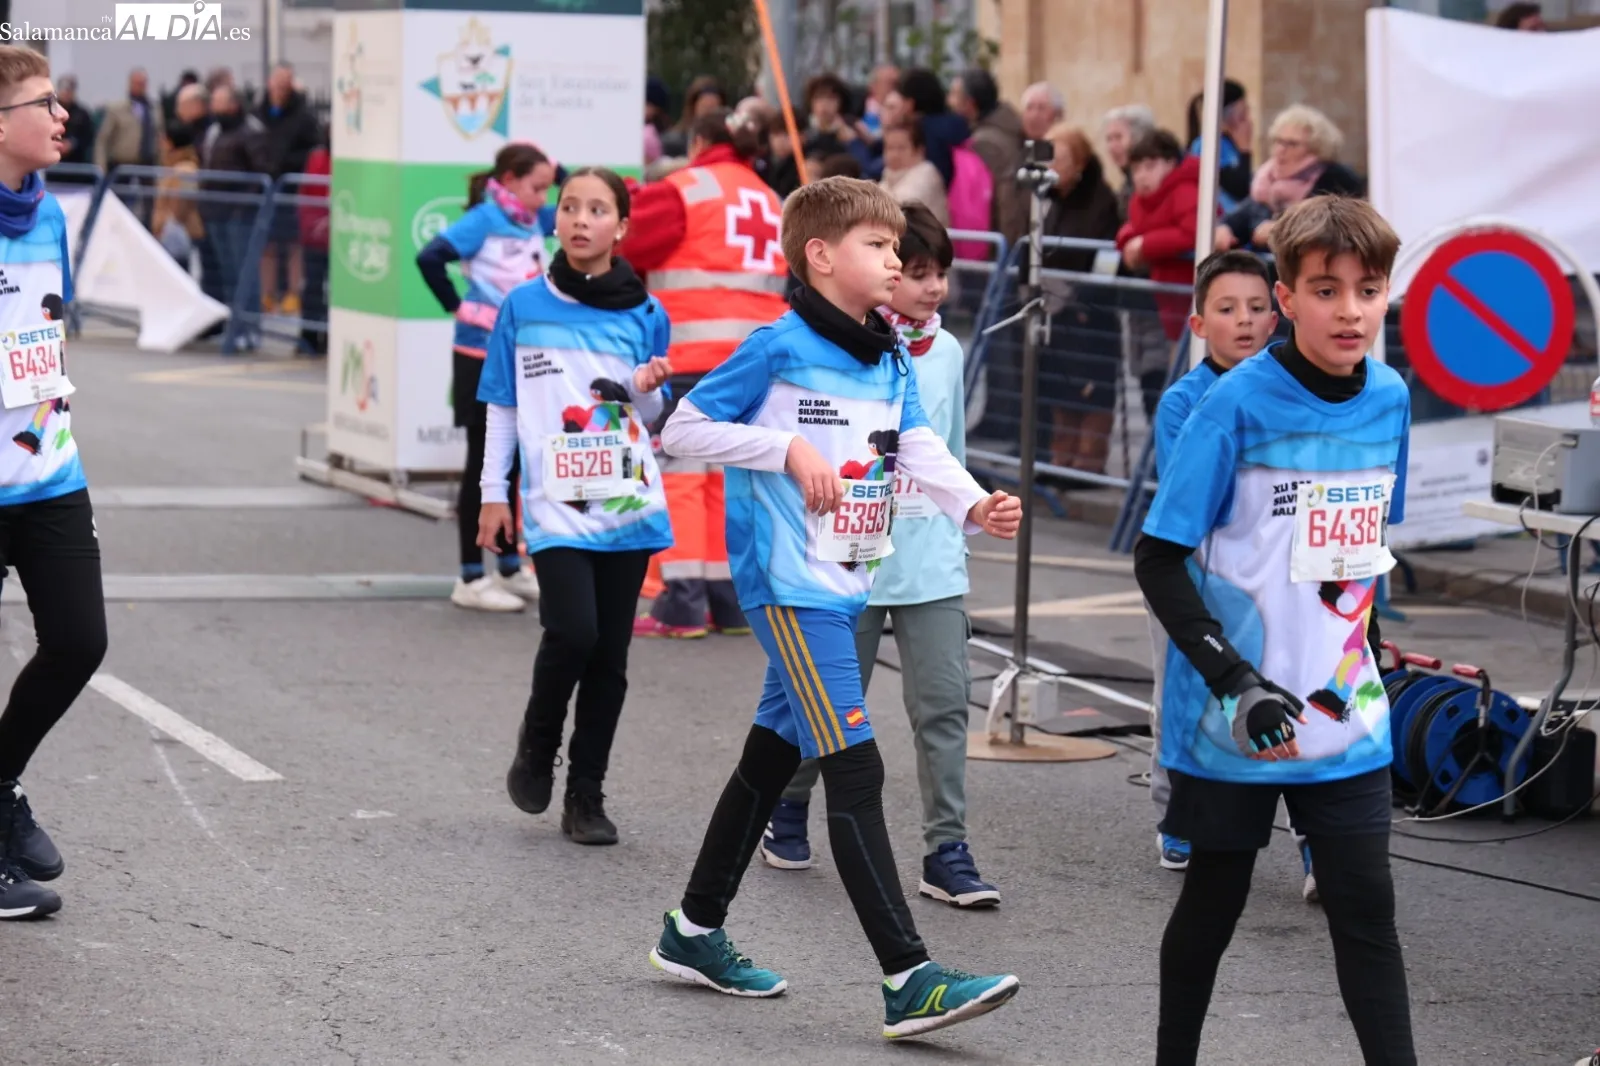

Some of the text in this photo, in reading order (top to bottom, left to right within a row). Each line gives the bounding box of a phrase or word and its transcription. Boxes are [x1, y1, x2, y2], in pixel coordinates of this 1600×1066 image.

[18, 326, 61, 345] SETEL
[9, 344, 57, 380] 6434
[798, 408, 838, 416] SILVESTRE
[814, 399, 831, 407] SAN
[798, 417, 849, 426] SALMANTINA
[567, 435, 624, 448] SETEL
[555, 449, 613, 479] 6526
[852, 484, 894, 498] SETEL
[1327, 484, 1386, 503] SETEL
[833, 501, 887, 534] 6393
[1308, 506, 1379, 547] 6438
